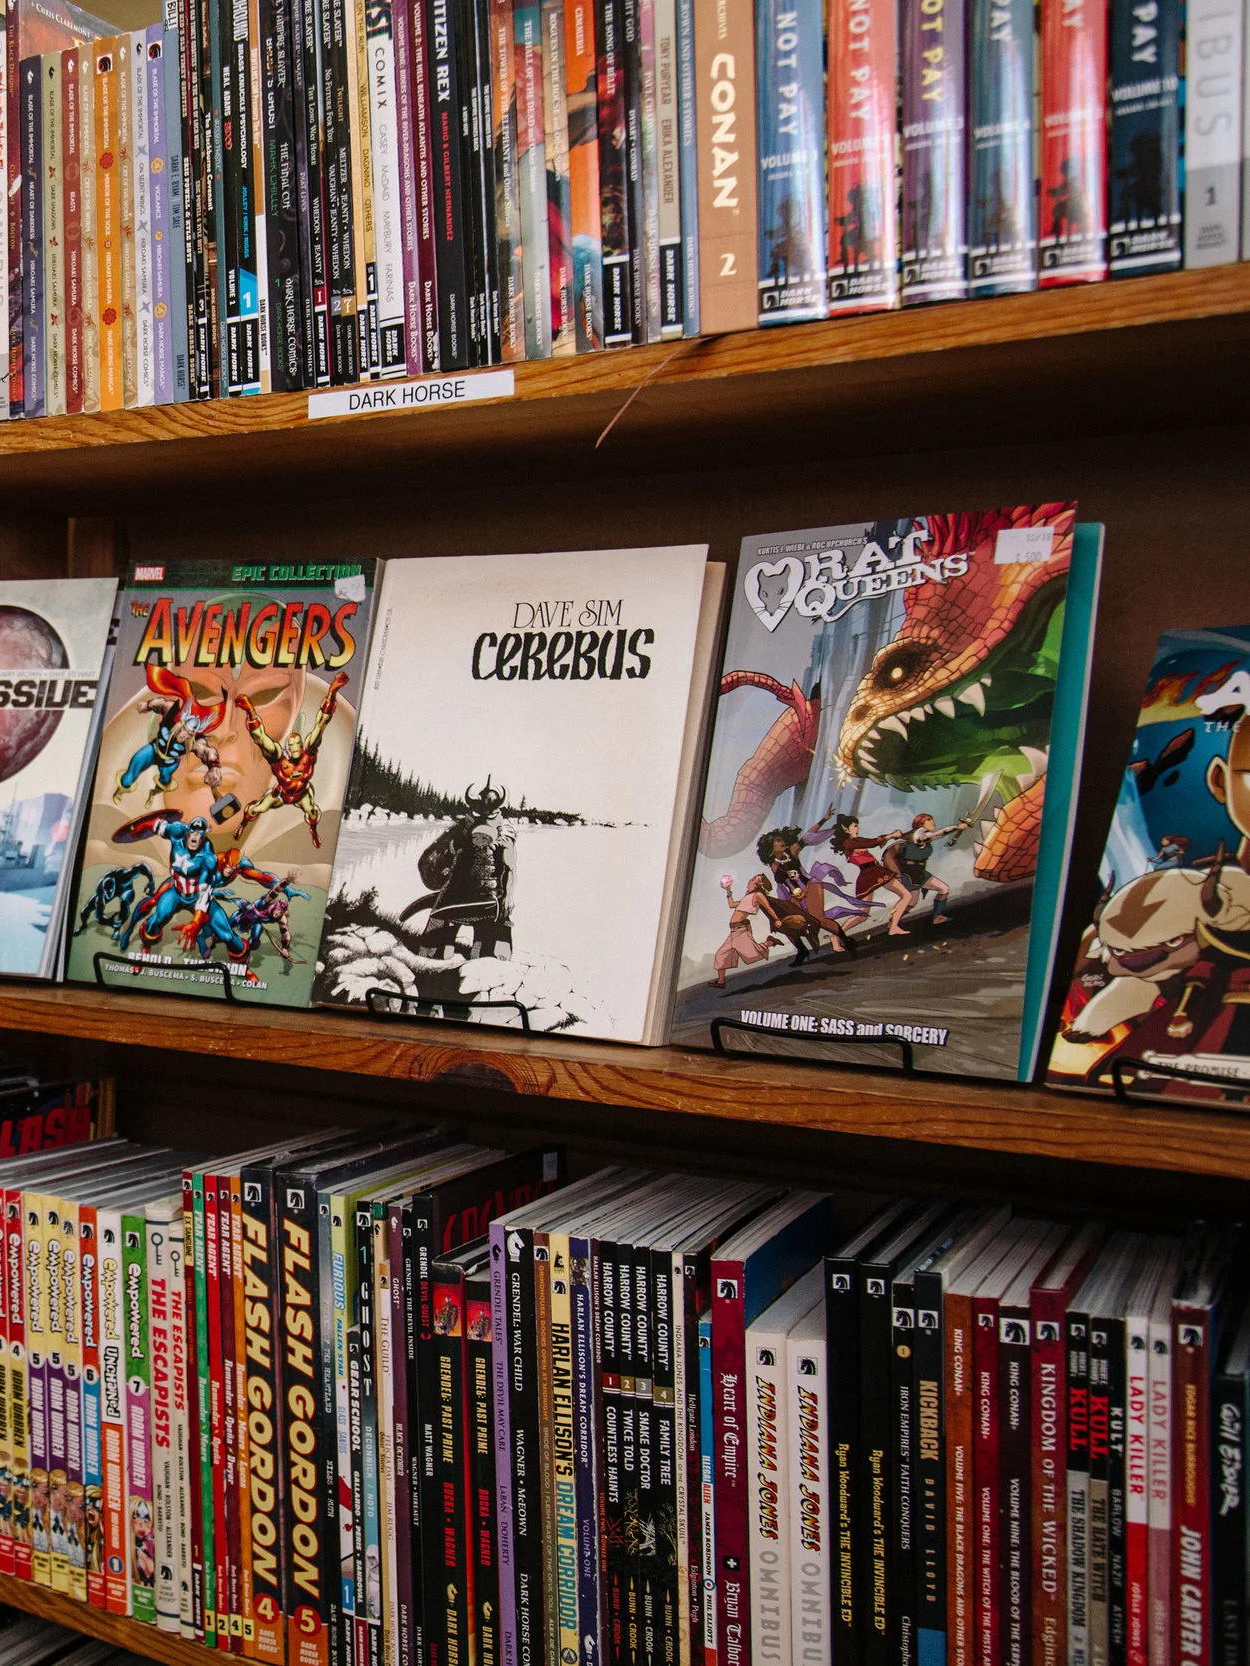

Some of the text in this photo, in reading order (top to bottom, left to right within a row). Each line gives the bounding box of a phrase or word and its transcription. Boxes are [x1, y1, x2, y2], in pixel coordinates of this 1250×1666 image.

[35, 4, 91, 38] CHRIS CLAREMONT
[1132, 2, 1158, 63] PAY
[375, 47, 387, 109] COMIX
[435, 65, 450, 103] REX
[777, 11, 798, 136] NOT PAY
[850, 66, 871, 121] PAY
[921, 46, 944, 103] PAY
[239, 113, 248, 169] PSYCHOLOGY
[659, 35, 674, 204] TONY PURYEAR ERIKA ALEXANDER
[710, 53, 739, 208] CONAN
[1205, 186, 1217, 206] 1
[665, 249, 676, 322] DARK HORSE
[719, 253, 737, 277] 2
[349, 380, 466, 411] DARK HORSE
[135, 566, 163, 580] MARVEL
[232, 563, 362, 582] EPIC COLLECTION
[794, 553, 970, 623] QUEENS
[804, 528, 933, 585] RAT
[131, 600, 149, 617] THE
[133, 597, 359, 670] AVENGERS
[512, 598, 625, 629] DAVE SIM
[104, 963, 134, 974] THOMAS
[140, 968, 148, 977] J.
[148, 968, 185, 981] BUSCEMA
[190, 974, 198, 982] S.
[199, 974, 236, 986] BUSCEA
[241, 979, 268, 990] COLAN
[740, 1009, 948, 1047] VOLUME ONE: SASS and SORCERY
[100, 1257, 120, 1342] empowered
[126, 1263, 144, 1359] empowered
[333, 1252, 346, 1311] FURIOUS
[602, 1261, 615, 1353] HARROW COUNTY
[132, 1379, 141, 1393] 7
[151, 1277, 171, 1449] THE ESCAPISTS
[953, 1328, 964, 1392] KING CONAN
[241, 1211, 279, 1589] FLASH GORDON
[283, 1217, 321, 1600] FLASH GORDON
[511, 1272, 528, 1537] GRENDEL: WAR CHILD WAGNER McEOWN
[720, 1373, 740, 1479] Heart of Empire
[919, 1380, 939, 1461] KICKBACK
[1070, 1386, 1088, 1452] KULL
[1129, 1375, 1145, 1496] LADY KILLER
[105, 1427, 122, 1511] ADAM WARREN
[131, 1404, 146, 1489] ADAM WARREN
[551, 1321, 578, 1630] HARLAN ELLISON'S DREAM CORRIDOR
[606, 1405, 619, 1504] COUNTLESS HAINTS
[797, 1384, 821, 1552] INDIANA JONES
[900, 1385, 910, 1550] IRON EMPIRES FAITH CONQUERS
[1040, 1362, 1057, 1594] KINGDOM OF THE WICKED
[704, 1511, 712, 1576] JAMES ROBINSON
[755, 1375, 781, 1660] INDIANA JONES OMNIBUS
[835, 1442, 852, 1622] Ryan Woodward's THE INVINCIBLE ED
[257, 1596, 274, 1621] 4
[299, 1608, 315, 1633] 5
[725, 1579, 742, 1666] Bryan Talbot
[1179, 1524, 1203, 1657] JOHN CARTER
